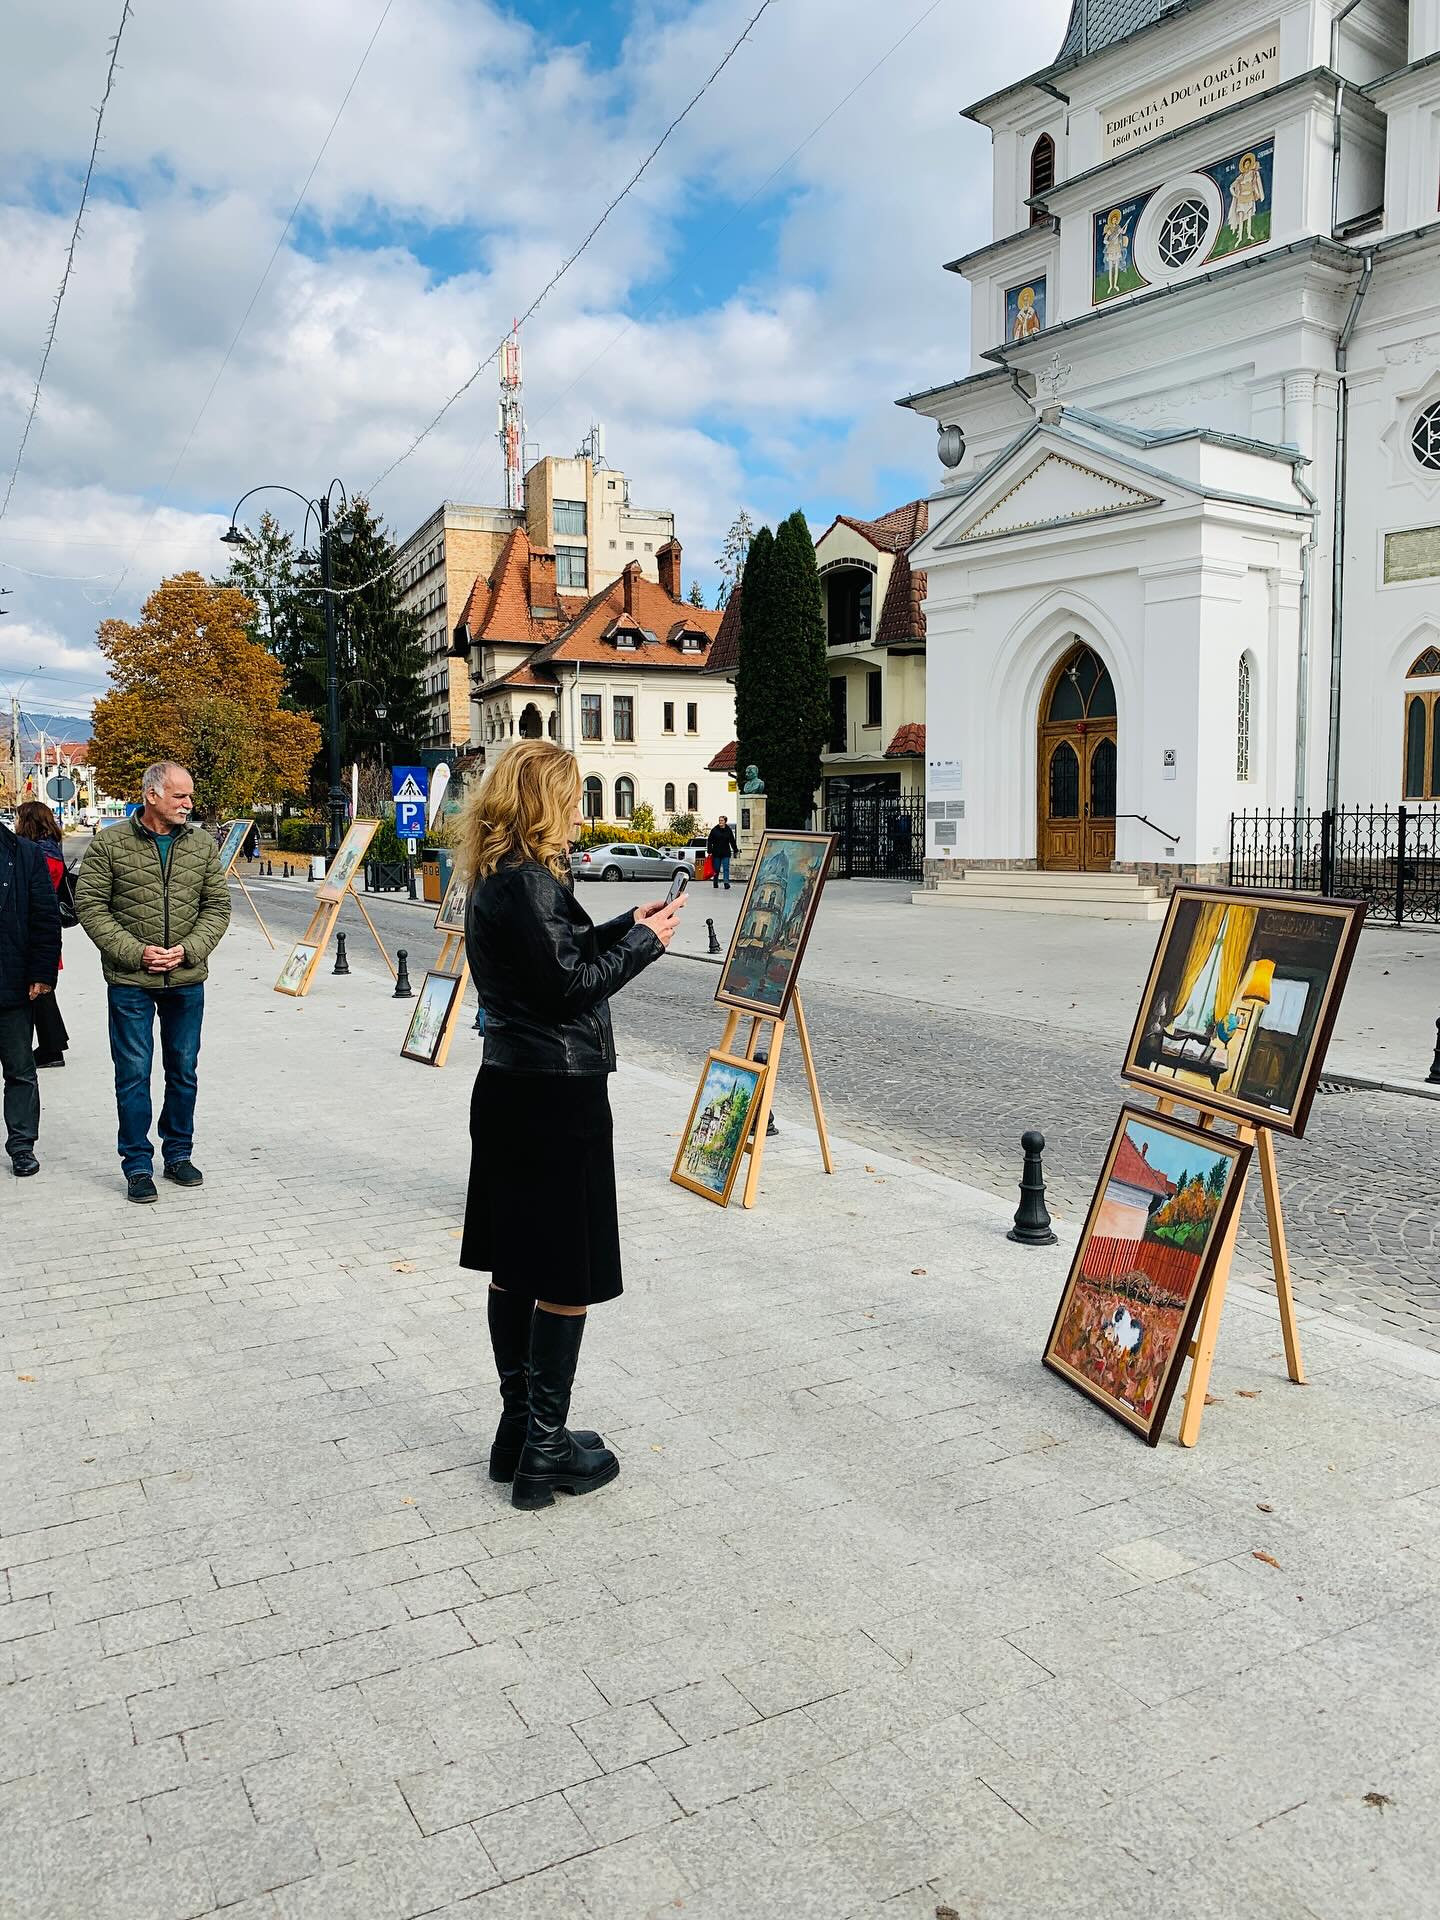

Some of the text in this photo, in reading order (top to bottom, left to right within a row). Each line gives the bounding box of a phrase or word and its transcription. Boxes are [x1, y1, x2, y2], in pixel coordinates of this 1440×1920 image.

[1106, 46, 1276, 135] EDIFICATĂ A DOUA OARĂ ÎN ANII
[1112, 69, 1265, 148] 1860 MAI 13 IULIE 12 1861
[402, 803, 418, 824] P
